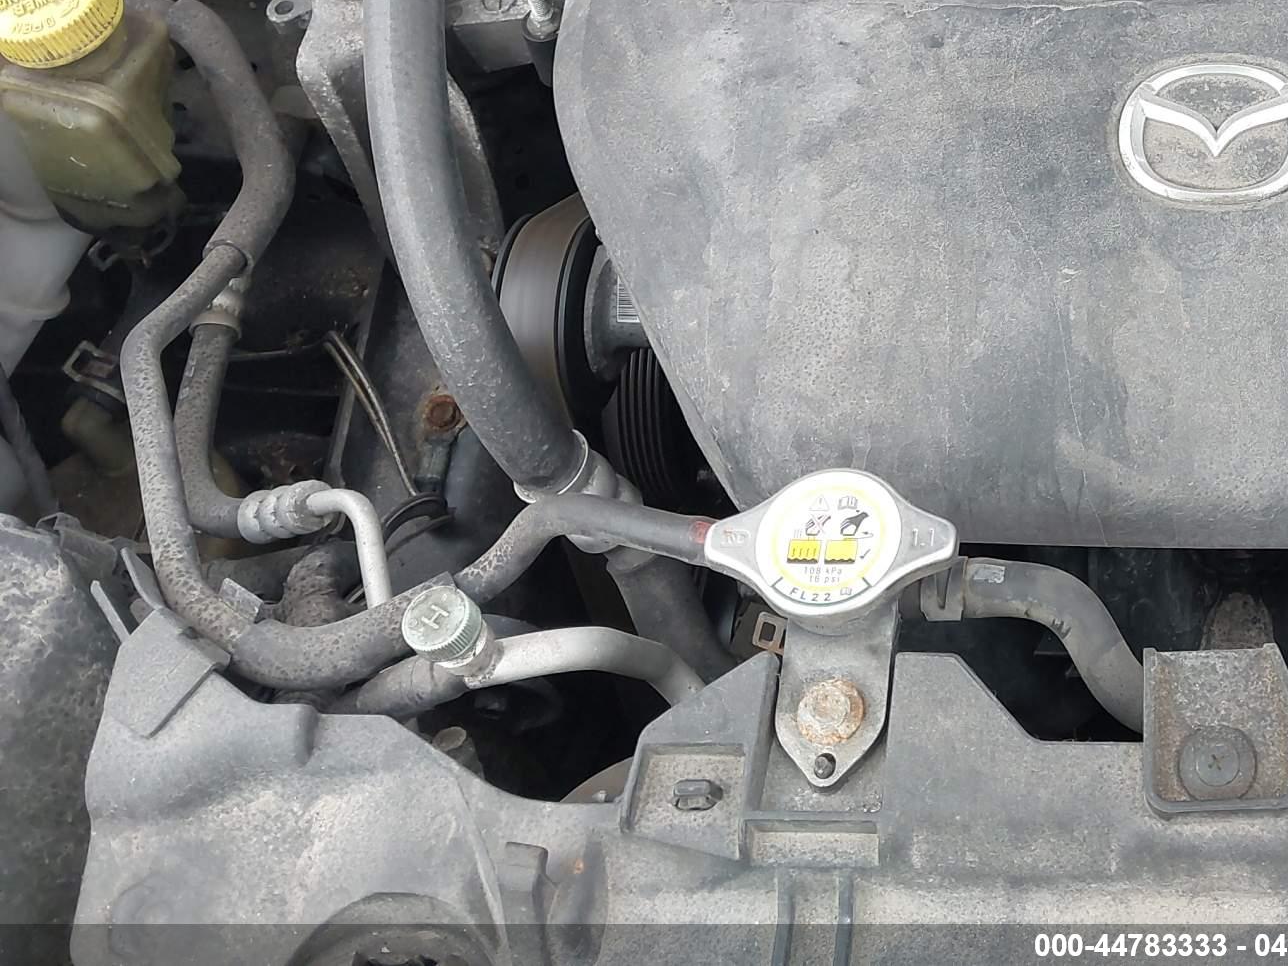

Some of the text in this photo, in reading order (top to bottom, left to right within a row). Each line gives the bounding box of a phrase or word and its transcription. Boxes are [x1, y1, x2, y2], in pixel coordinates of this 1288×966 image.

[911, 527, 935, 547] 1.1
[804, 566, 821, 575] 108
[809, 575, 841, 584] 16 psi
[789, 587, 832, 602] FL22
[420, 604, 450, 629] H
